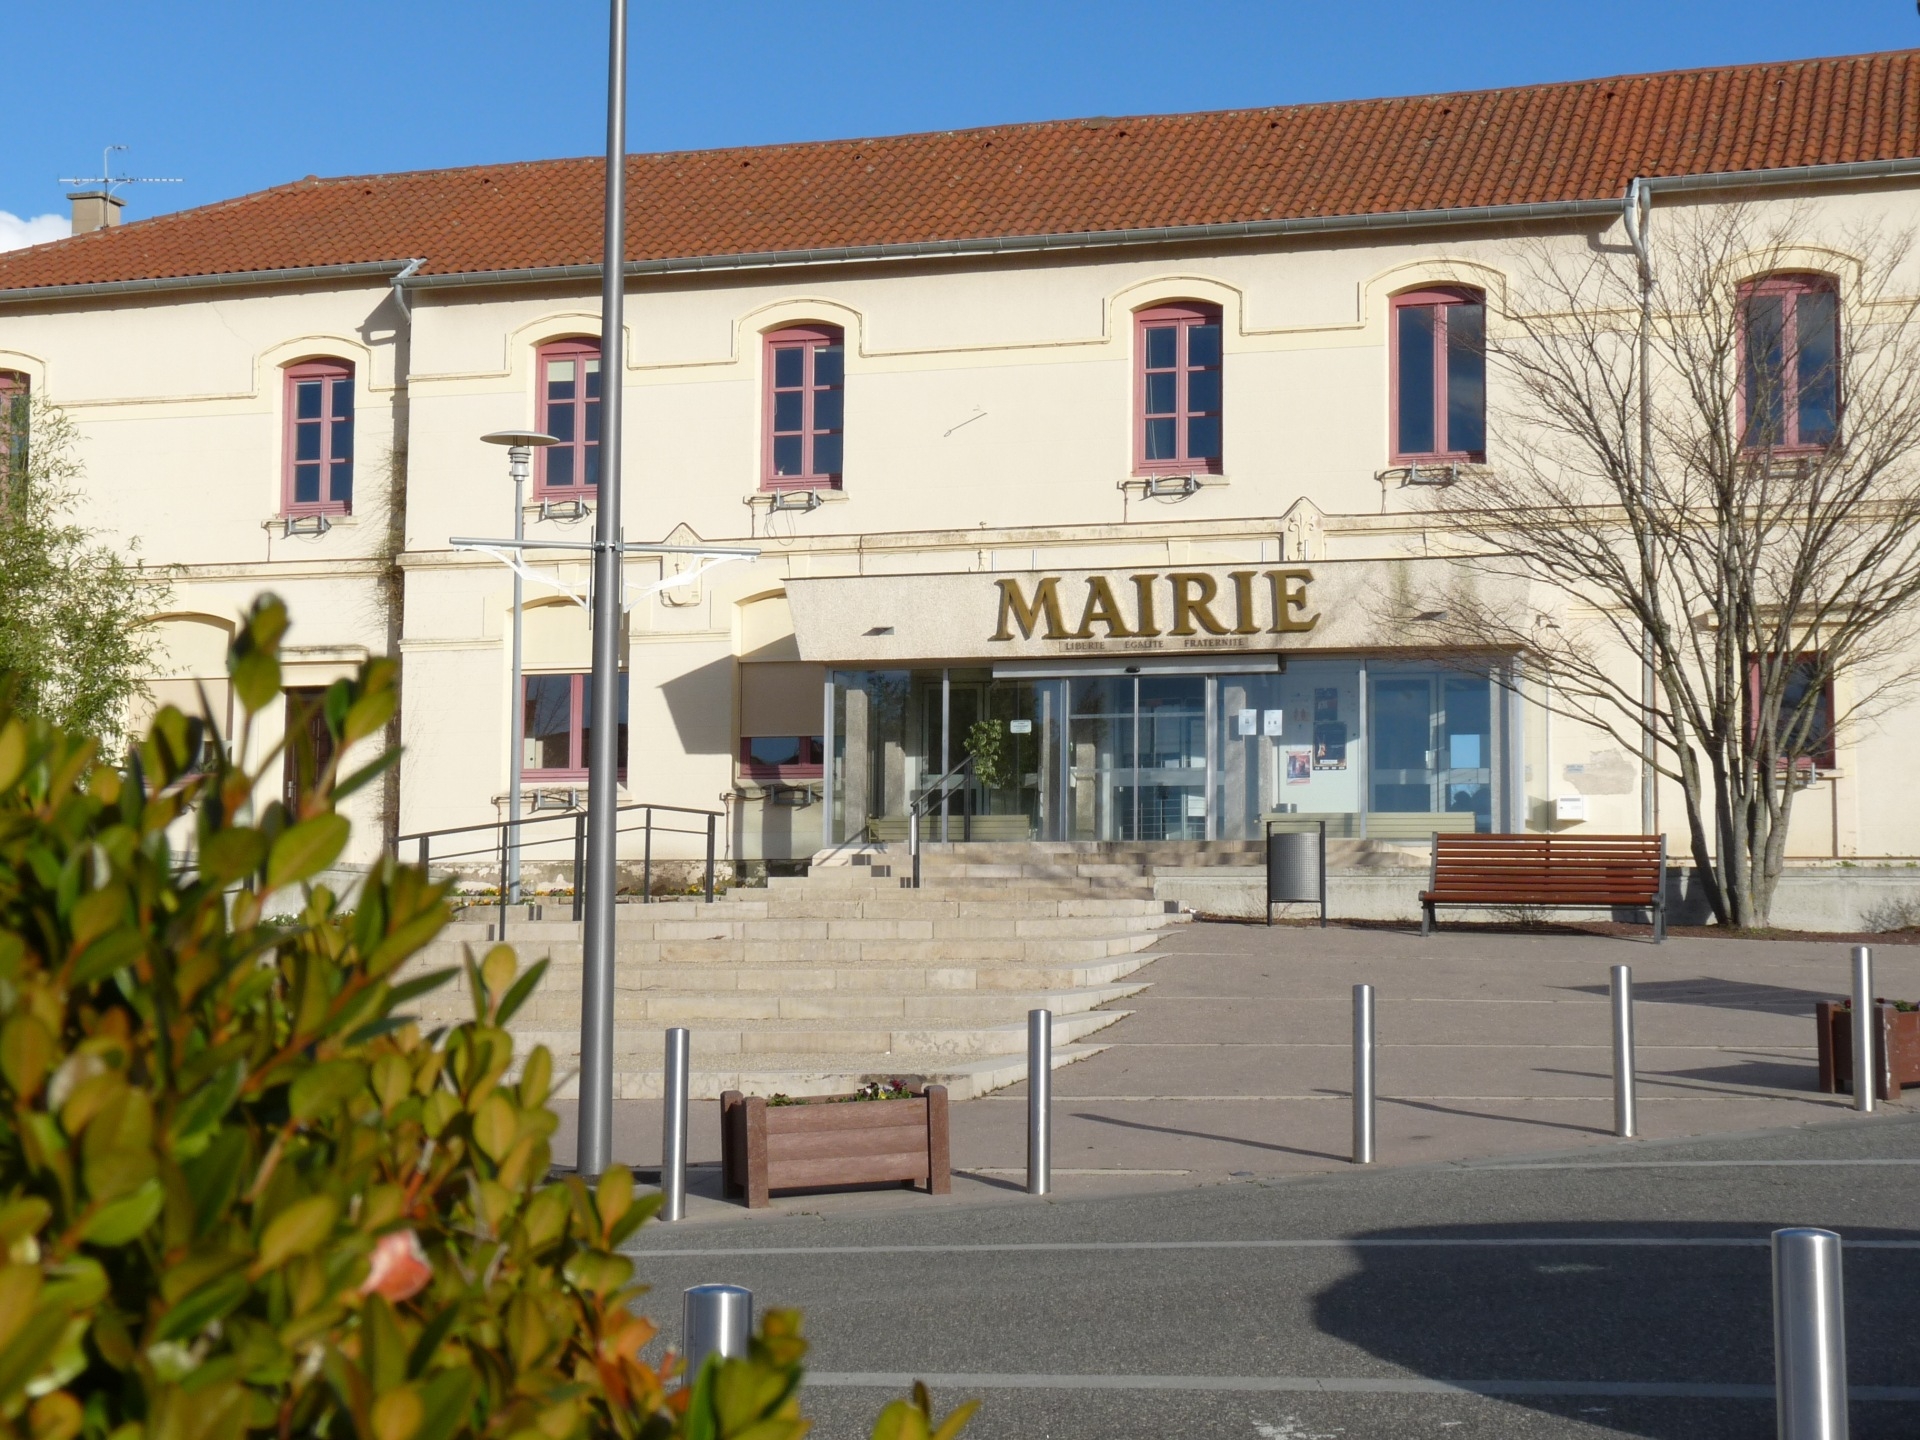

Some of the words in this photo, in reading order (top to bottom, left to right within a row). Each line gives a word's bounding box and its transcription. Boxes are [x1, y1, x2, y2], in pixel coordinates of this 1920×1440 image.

[988, 569, 1321, 641] MAIRIE
[1065, 641, 1105, 650] LIBERTE
[1125, 640, 1164, 649] EGALITE
[1184, 638, 1244, 647] FRATERNITE
